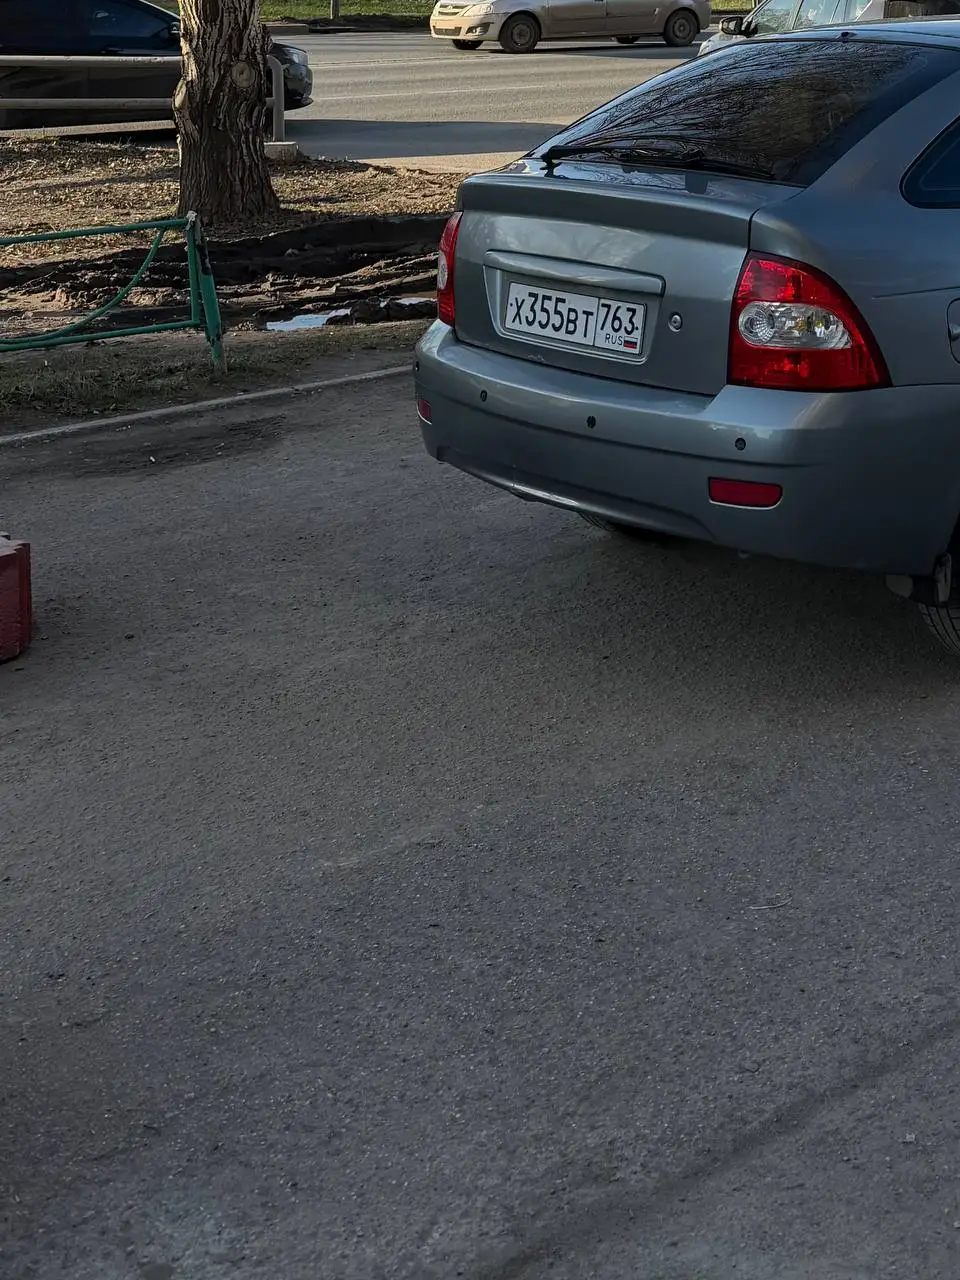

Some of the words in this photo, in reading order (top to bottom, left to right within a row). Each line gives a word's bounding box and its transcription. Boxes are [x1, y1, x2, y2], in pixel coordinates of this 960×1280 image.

[511, 291, 594, 338] Х355ВТ
[600, 303, 637, 336] 763
[604, 333, 624, 346] RUS
